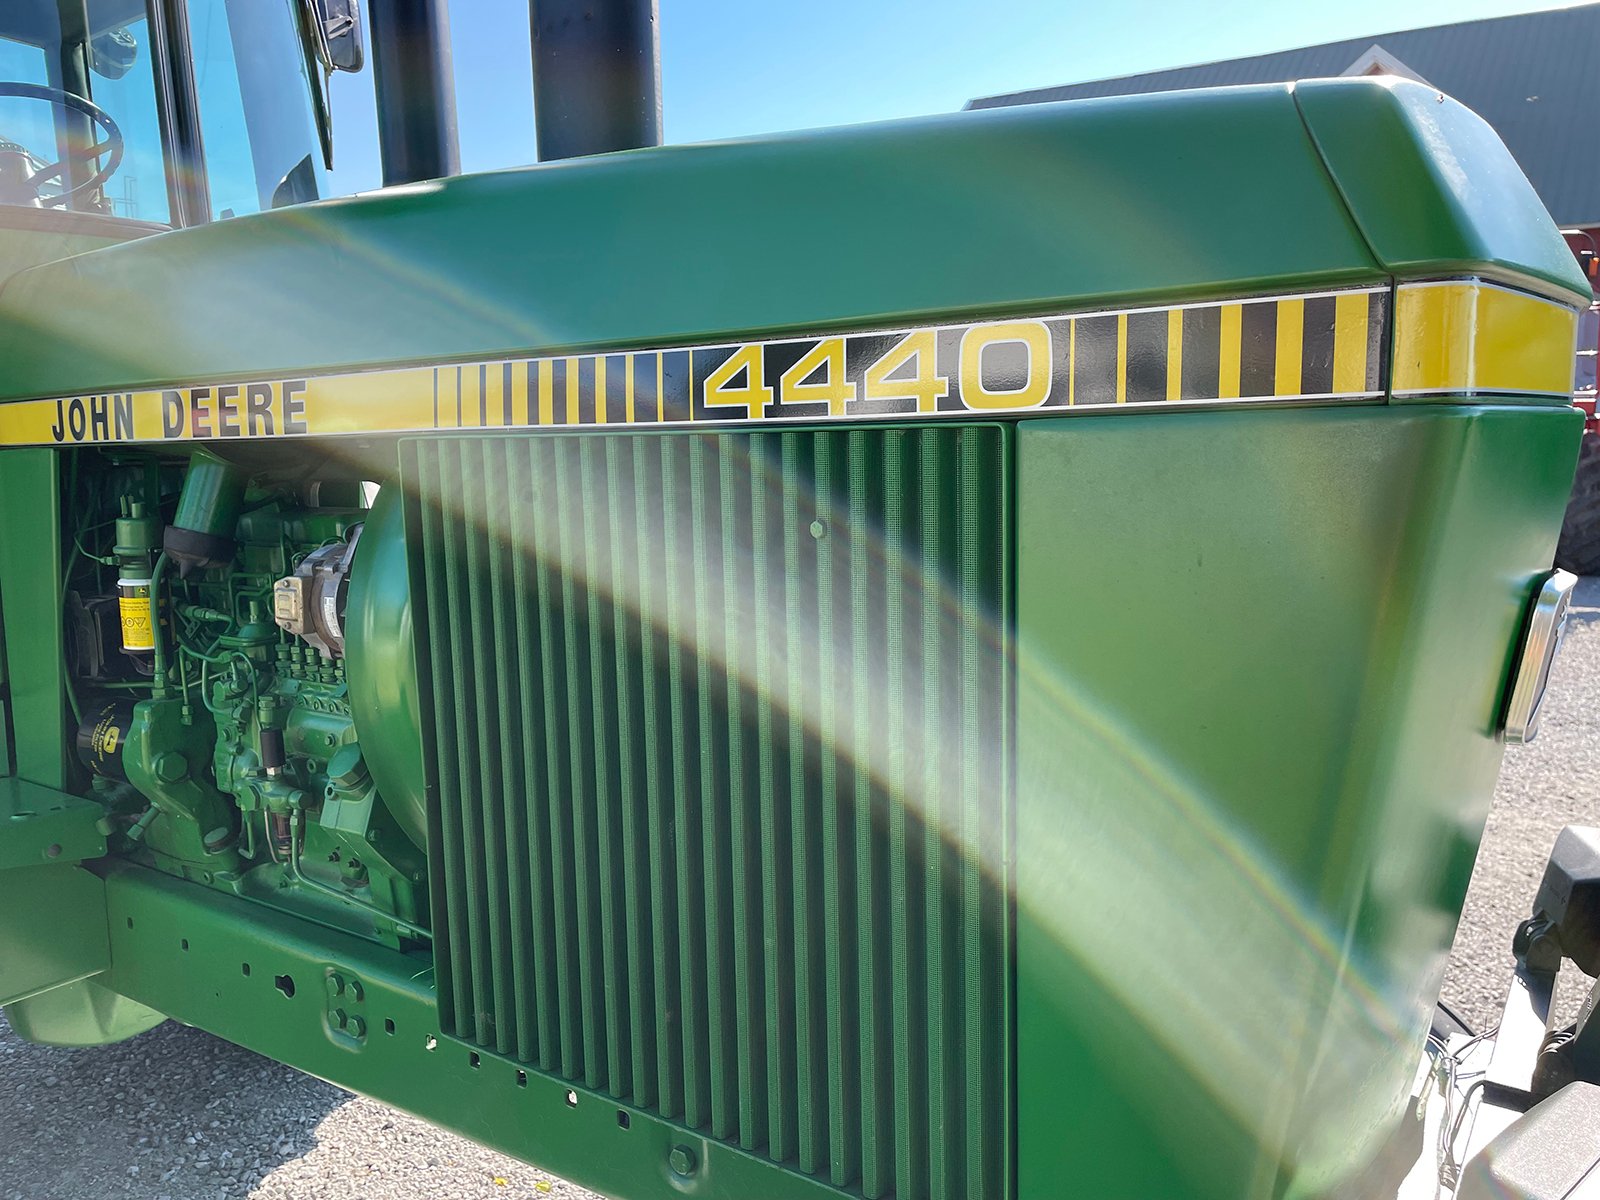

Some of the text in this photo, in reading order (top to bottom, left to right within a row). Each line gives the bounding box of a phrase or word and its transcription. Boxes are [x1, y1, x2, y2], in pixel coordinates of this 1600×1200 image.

[52, 379, 308, 443] JOHN DEERE
[703, 320, 1053, 420] 4440
